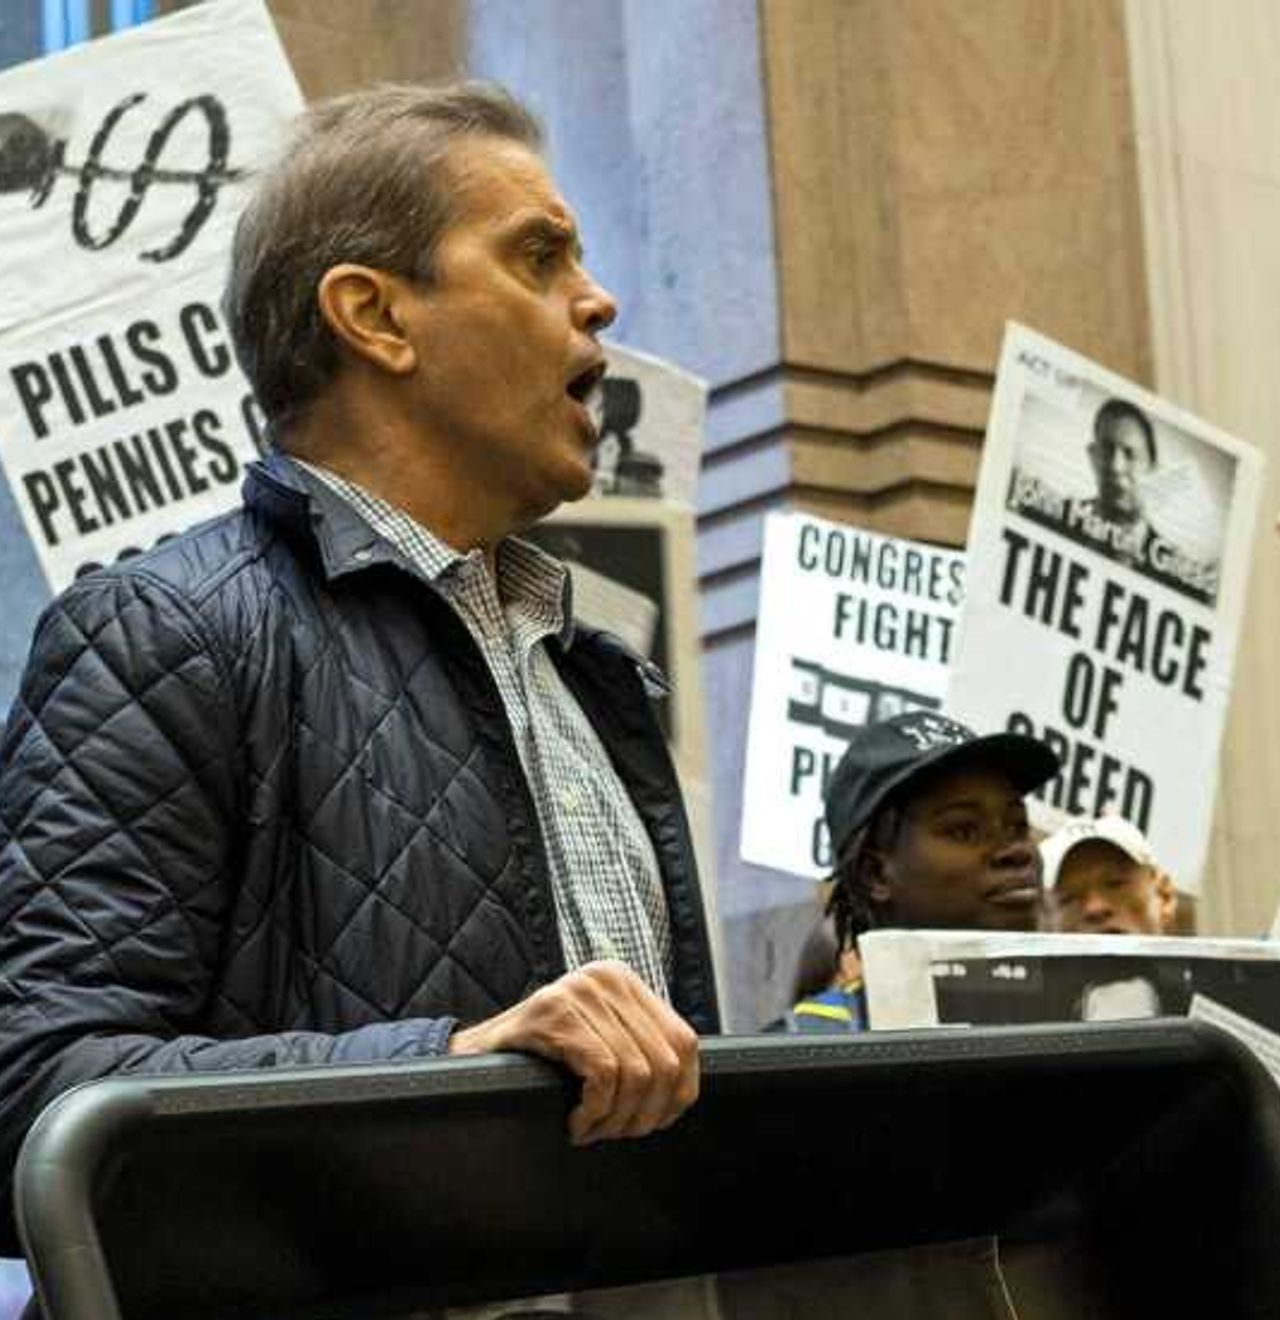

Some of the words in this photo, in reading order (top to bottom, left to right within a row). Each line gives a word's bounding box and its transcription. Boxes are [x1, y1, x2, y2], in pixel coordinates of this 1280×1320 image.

[10, 319, 178, 440] PILLS
[22, 408, 239, 546] PENNIES
[834, 596, 955, 664] FIGHT
[999, 528, 1088, 642] THE
[1095, 578, 1212, 702] FACE
[1063, 651, 1123, 740] OF
